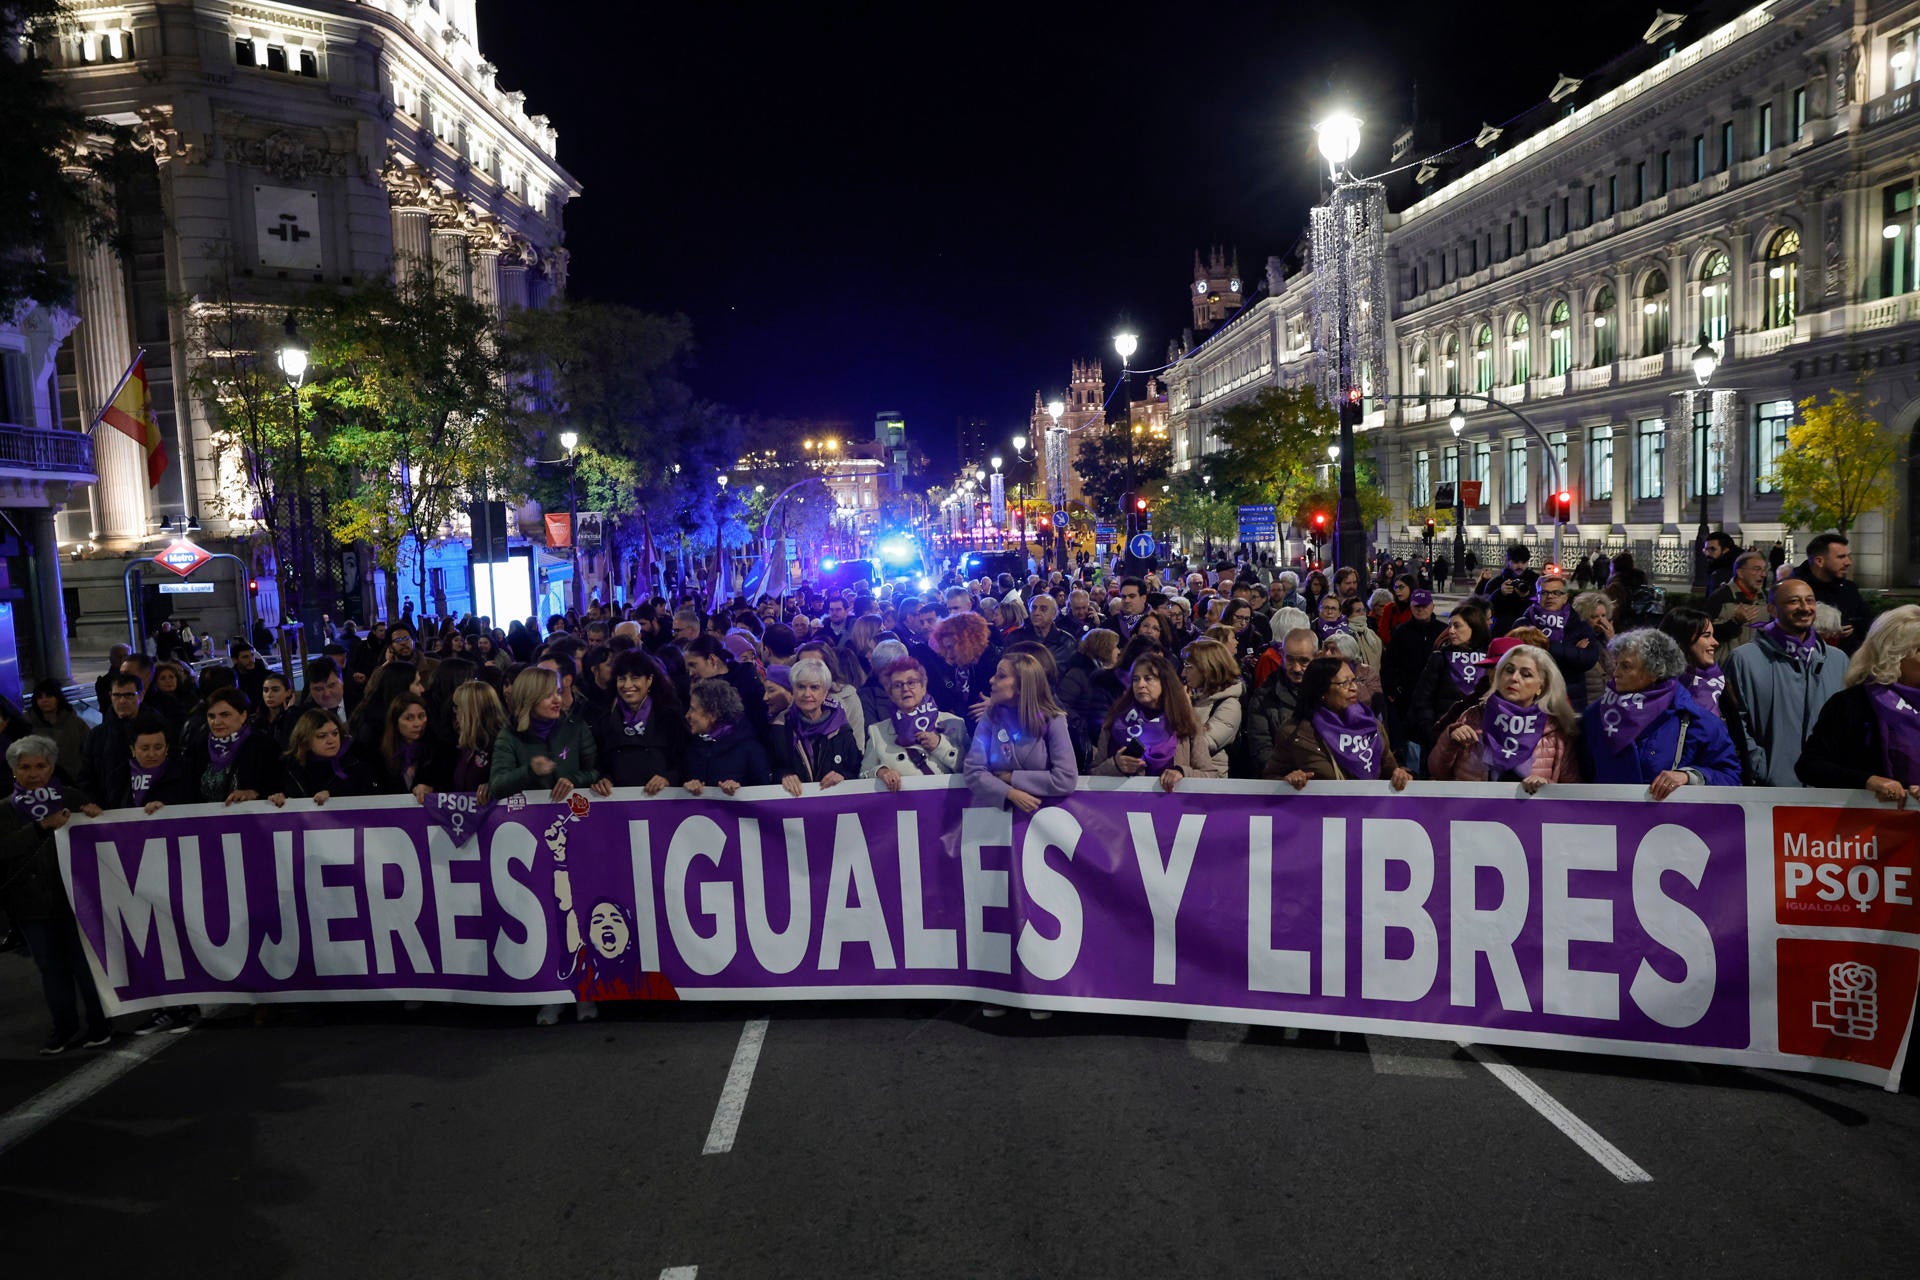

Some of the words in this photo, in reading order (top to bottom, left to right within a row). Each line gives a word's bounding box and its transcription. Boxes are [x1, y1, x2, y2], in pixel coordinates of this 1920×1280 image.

[169, 553, 194, 563] Metro
[1339, 733, 1377, 753] PSO
[437, 792, 478, 814] PSOE
[1783, 832, 1879, 861] Madrid
[1783, 861, 1913, 913] PSOE
[95, 821, 548, 988] MUJERES
[628, 806, 1083, 981] IGUALES
[1126, 811, 1207, 986] Y
[1248, 815, 1717, 1029] LIBRES
[1785, 901, 1852, 912] IGUALDAD
